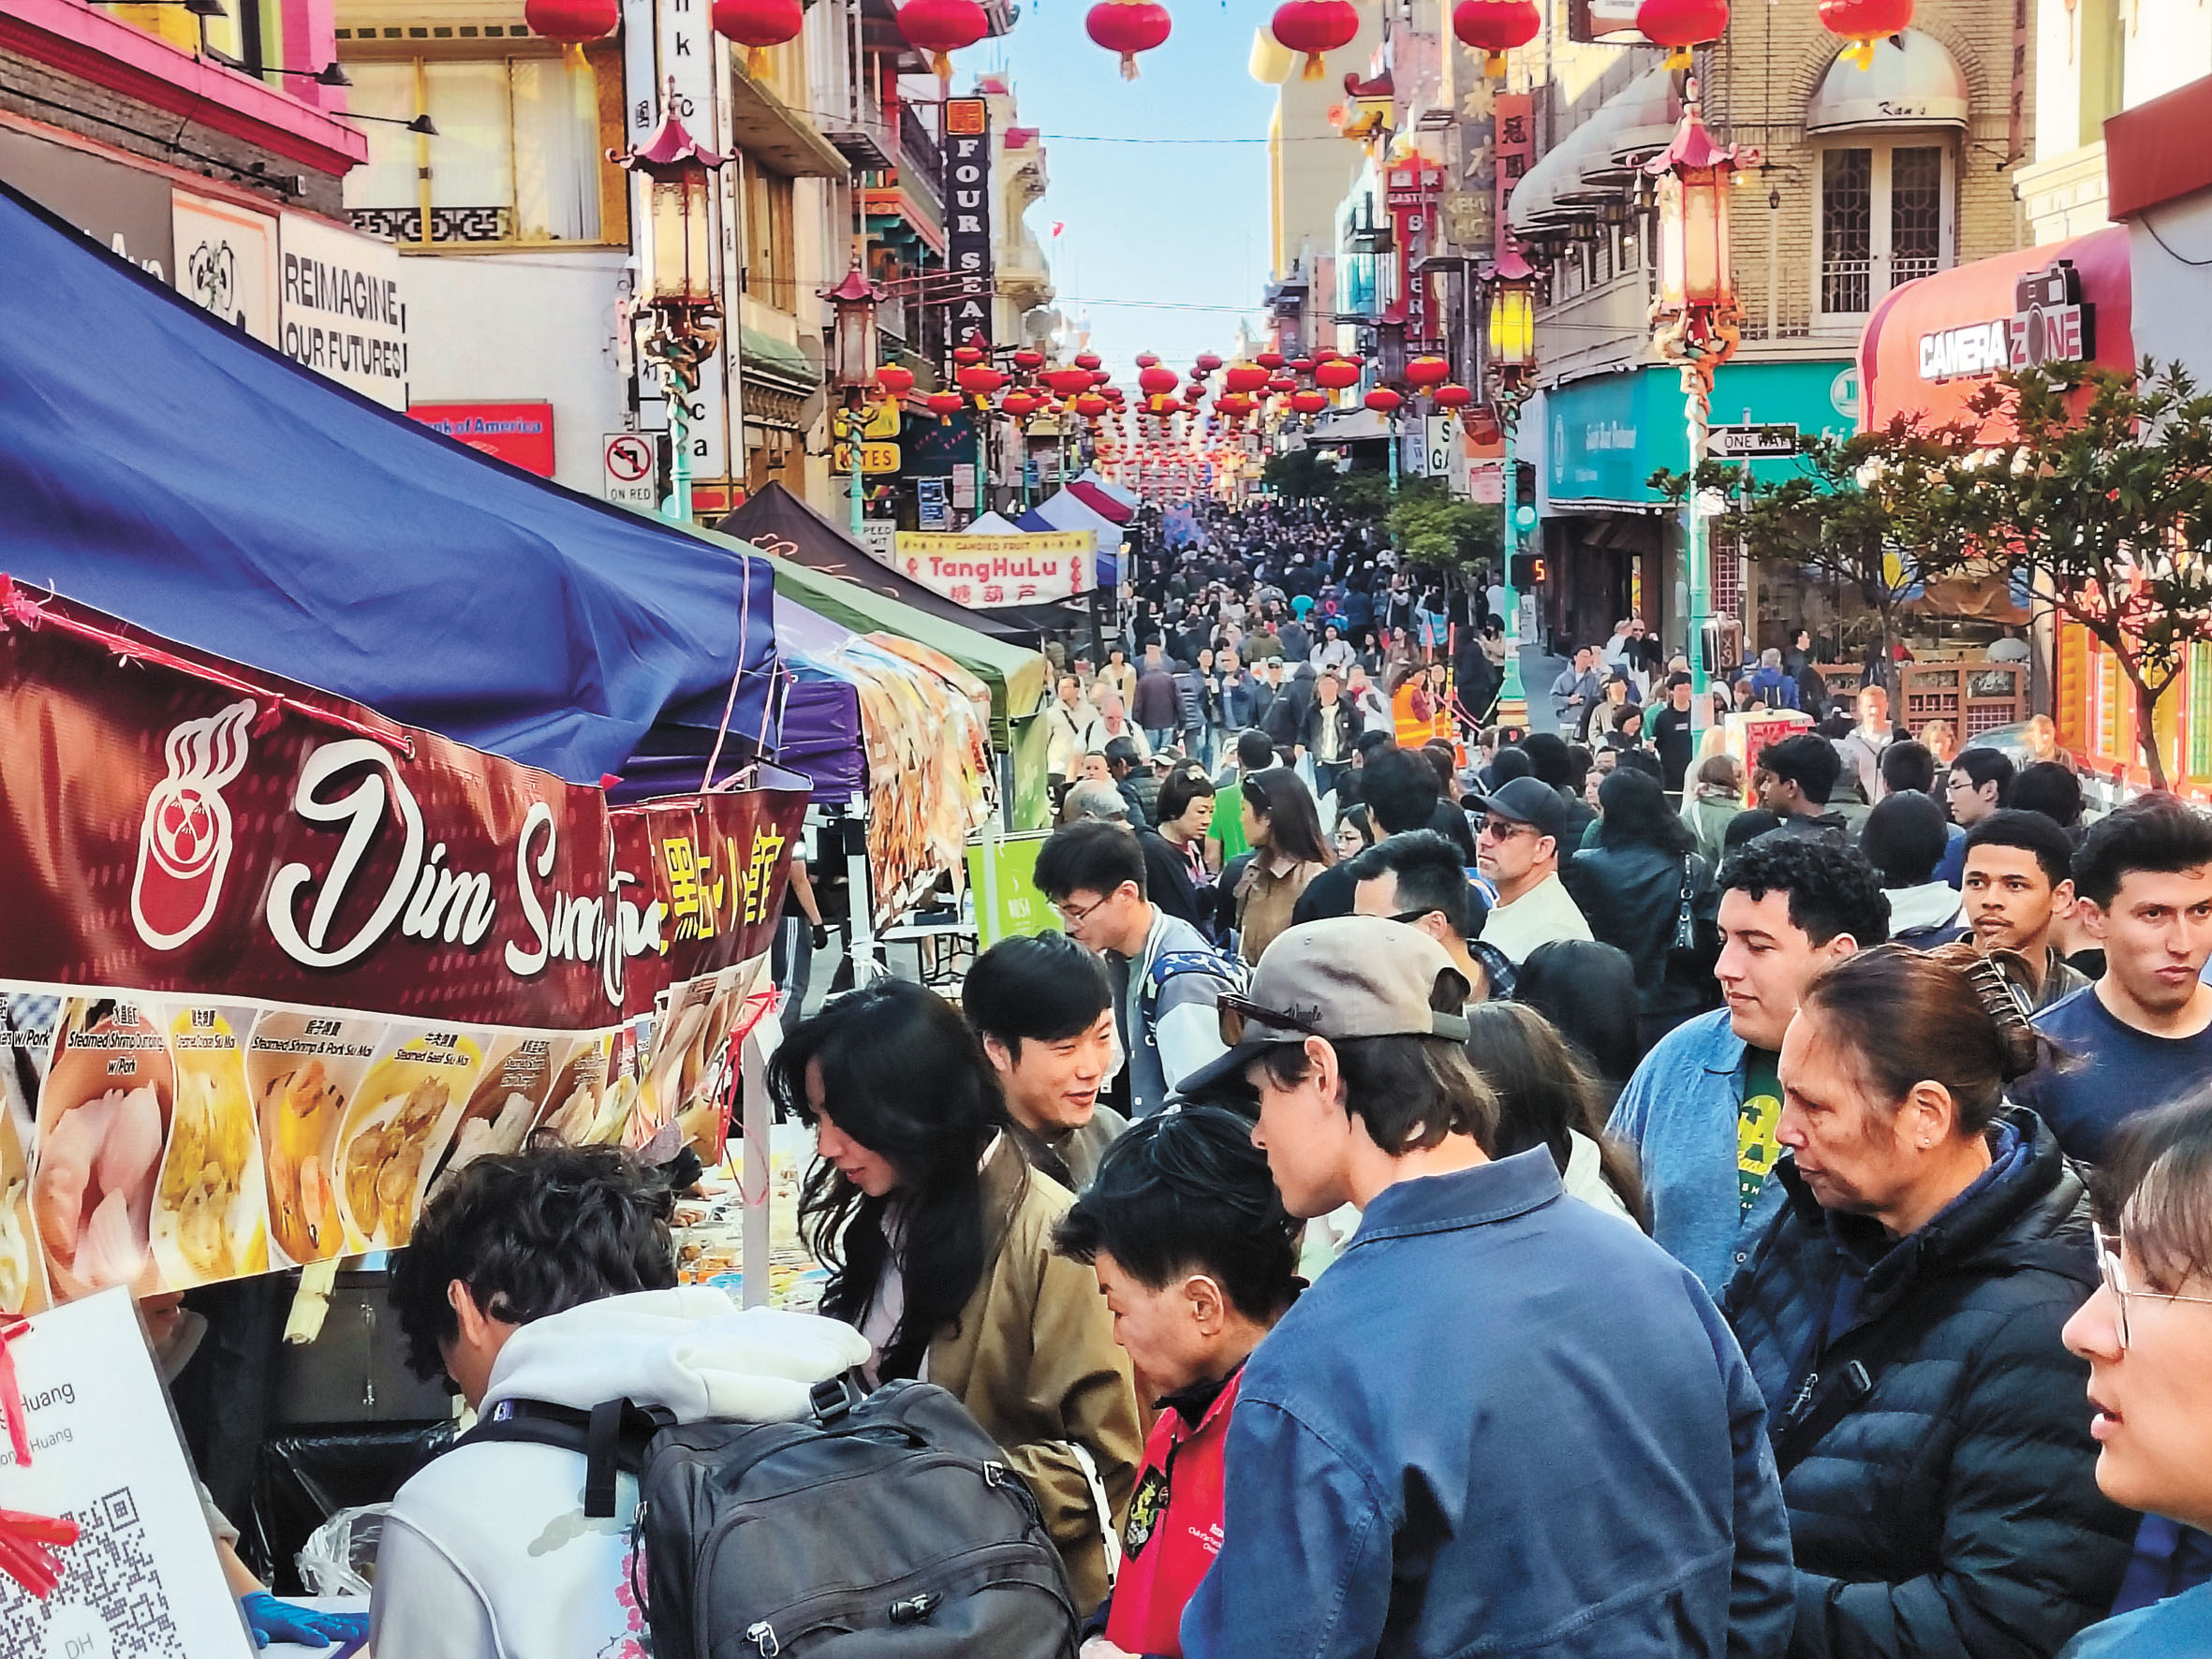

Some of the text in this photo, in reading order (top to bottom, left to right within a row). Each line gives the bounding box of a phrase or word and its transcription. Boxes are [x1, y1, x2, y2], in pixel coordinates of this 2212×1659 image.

[956, 139, 982, 233] FOUR
[284, 252, 398, 326] REIMAGINE
[959, 251, 985, 344] SEAS
[286, 321, 401, 379] OUR FUTURES
[1920, 319, 2009, 379] CAMERA
[456, 418, 472, 433] of
[474, 417, 542, 433] America
[1724, 435, 1753, 448] ONE
[840, 449, 892, 467] KTES
[610, 488, 651, 501] ON RED
[863, 525, 892, 536] PEED
[929, 556, 1057, 583] TangHuLu
[1535, 559, 1546, 582] 5
[266, 738, 496, 968] Dim
[659, 822, 786, 956] 點小館
[67, 1031, 110, 1048] Steamed
[30, 1428, 74, 1453] Huang
[65, 1632, 95, 1659] DH
